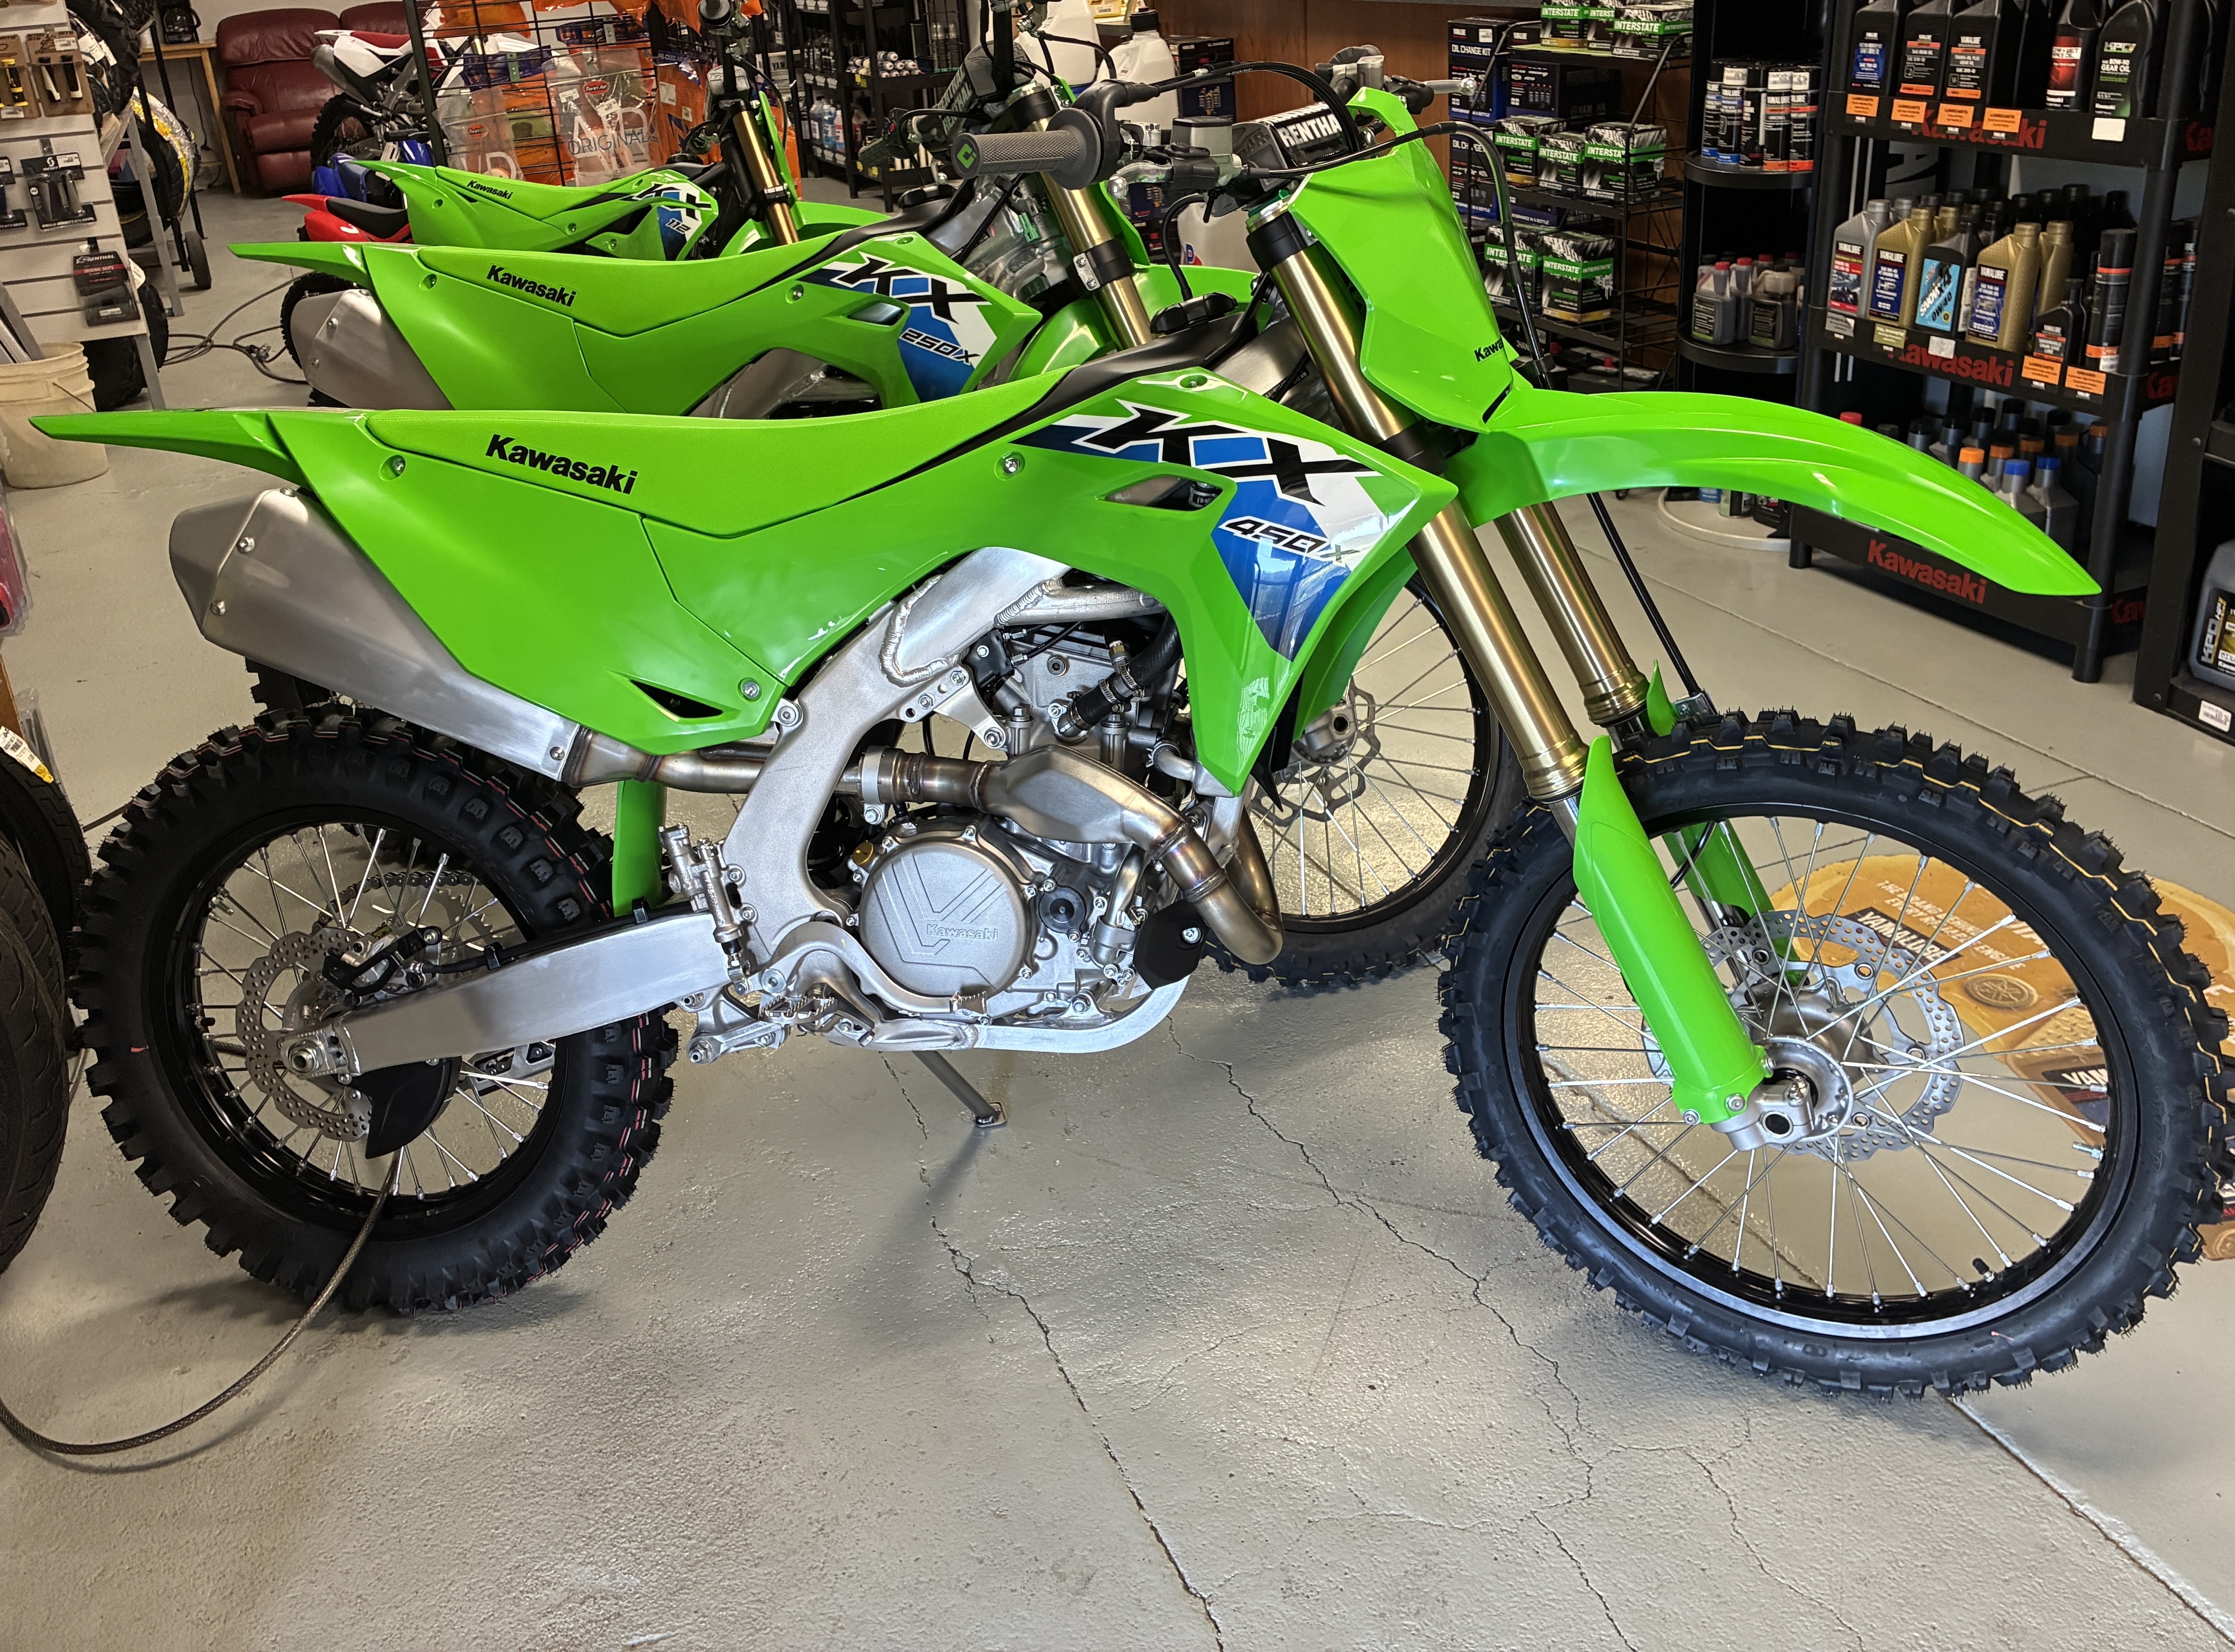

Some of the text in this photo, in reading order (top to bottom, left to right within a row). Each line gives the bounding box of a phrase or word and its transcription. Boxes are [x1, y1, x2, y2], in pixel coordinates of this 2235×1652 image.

[1541, 8, 1579, 17] INTERSTATE
[1590, 9, 1615, 17] INTERST
[1614, 20, 1659, 32] INTERSTATE
[1277, 113, 1343, 148] RENTHA
[568, 129, 650, 155] ORIGINAL
[1496, 135, 1534, 147] INTERSTATE
[1539, 147, 1578, 162] INTERSTATE
[1587, 147, 1626, 158] INTERSTA
[467, 180, 514, 199] Kawasaki
[666, 218, 691, 234] 112
[1543, 260, 1581, 274] INTERSTATE
[486, 264, 577, 307] Kawasaki
[832, 253, 992, 324] KX
[900, 328, 981, 364] 250X
[1074, 400, 1383, 506] KX
[485, 434, 638, 495] Kawasaki
[1867, 539, 1988, 604] Kawasaki
[926, 923, 998, 940] Kawasaki
[1857, 911, 1950, 962] YAMALUBE
